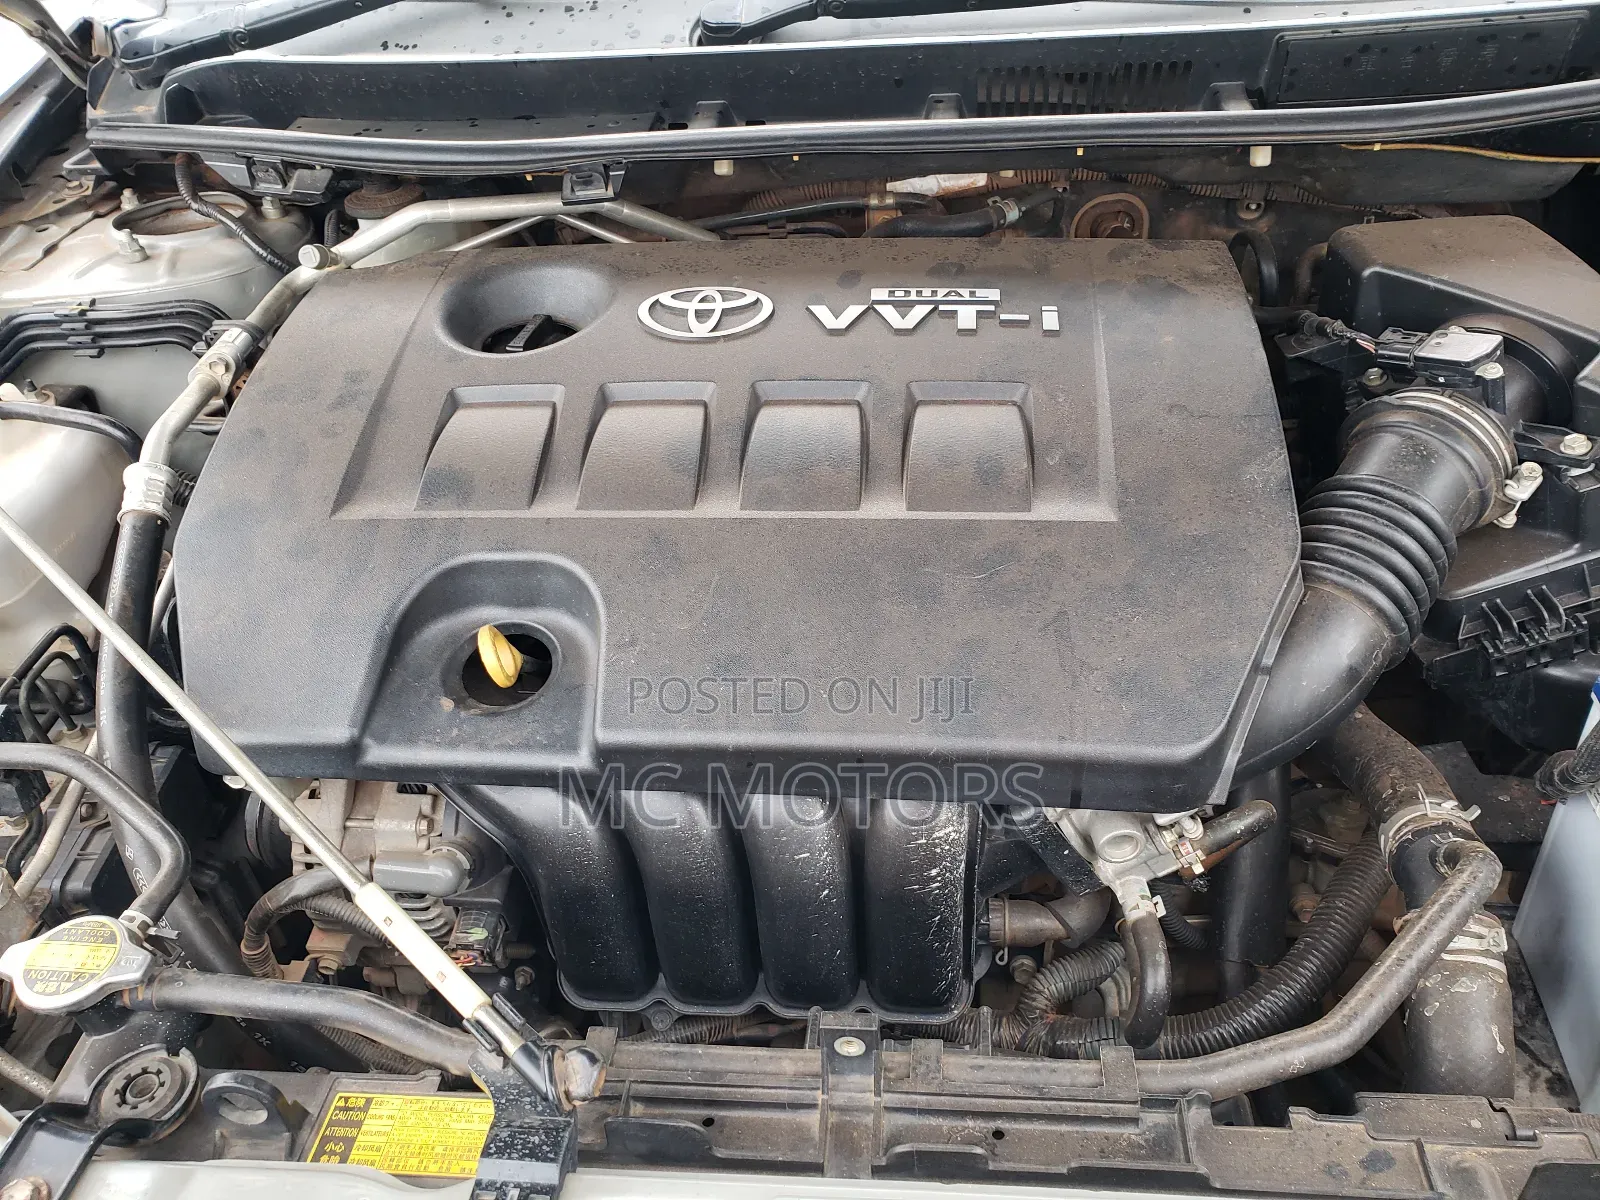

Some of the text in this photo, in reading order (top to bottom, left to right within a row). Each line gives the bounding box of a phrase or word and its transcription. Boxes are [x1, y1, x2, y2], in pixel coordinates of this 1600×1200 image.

[887, 289, 990, 298] DUAL
[806, 304, 1060, 335] VVT-i
[62, 935, 104, 943] ENGINE
[28, 969, 90, 982] CAUTION
[332, 1110, 367, 1121] CAUTION
[324, 1127, 360, 1137] ATTENTION
[324, 1141, 345, 1153] 小心
